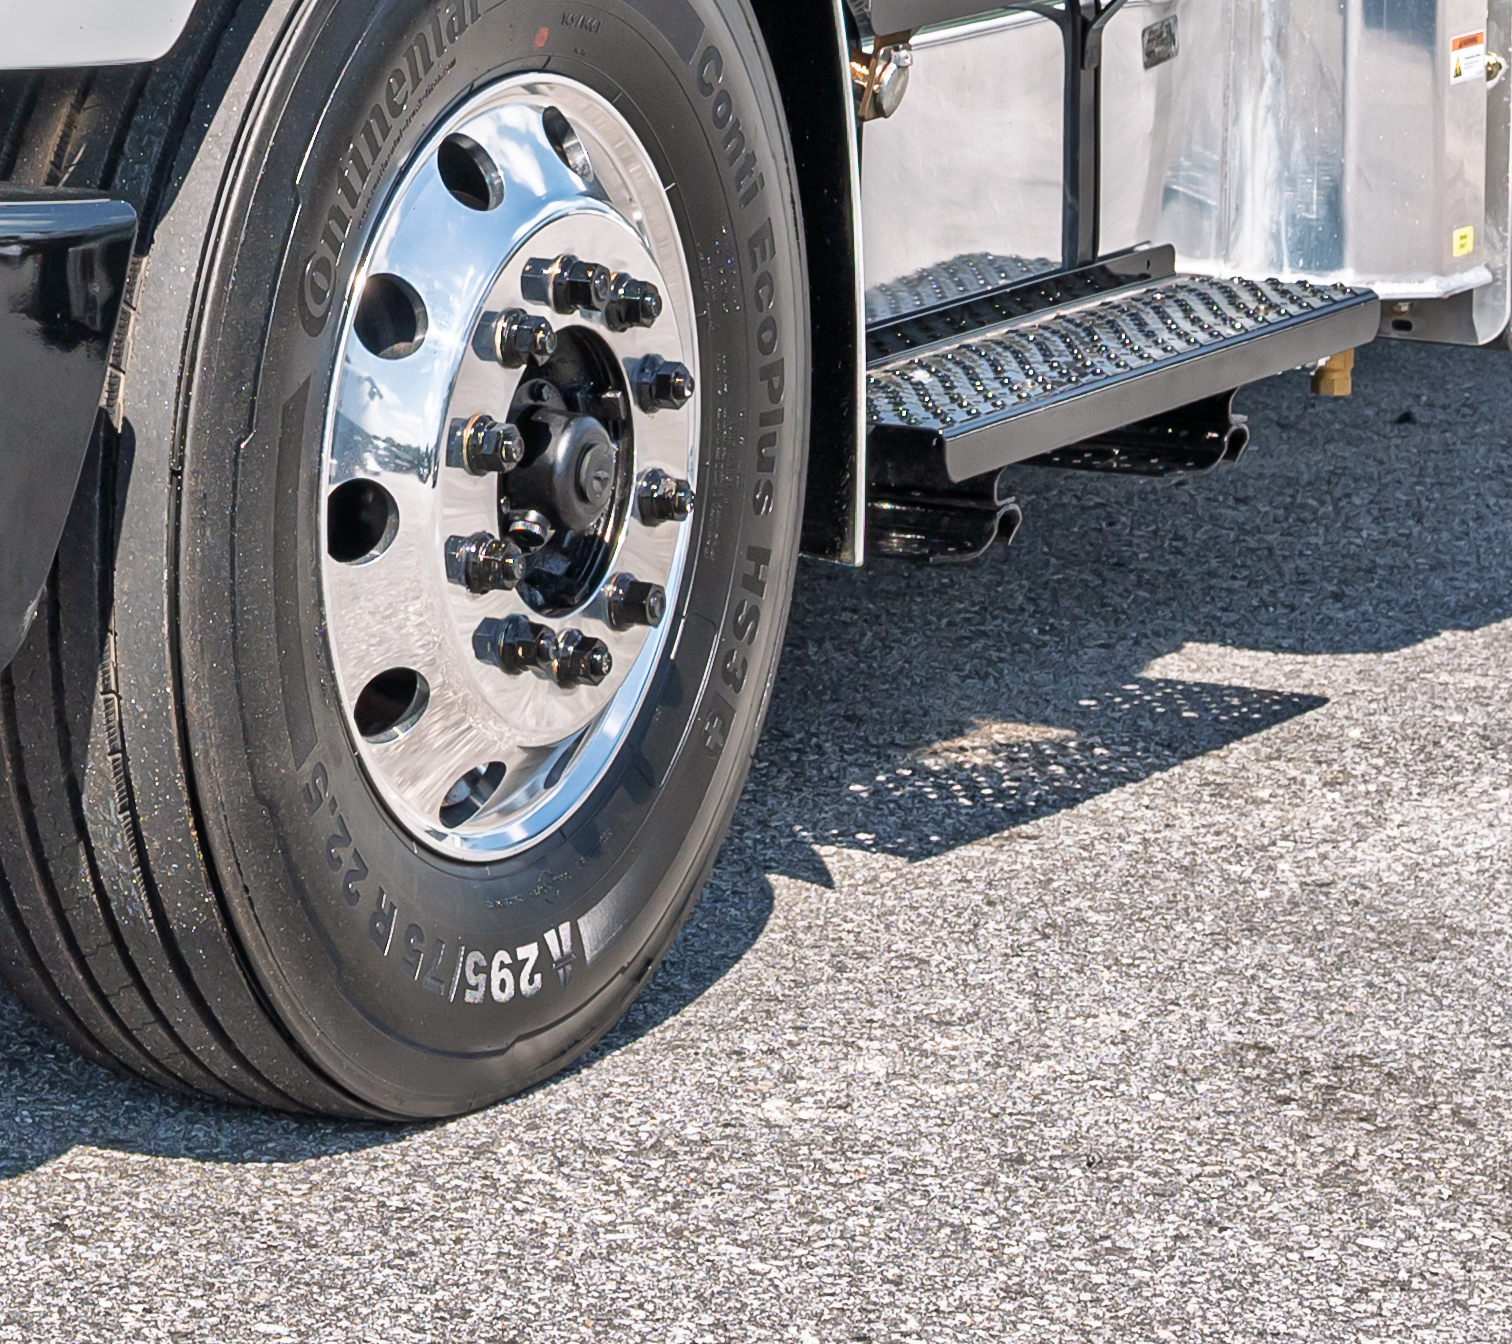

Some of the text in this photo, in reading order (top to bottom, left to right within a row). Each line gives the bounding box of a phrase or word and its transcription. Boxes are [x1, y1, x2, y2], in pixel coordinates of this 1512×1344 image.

[695, 44, 766, 211] Conti
[747, 216, 785, 518] EcoPlus
[302, 760, 369, 907] 22.5
